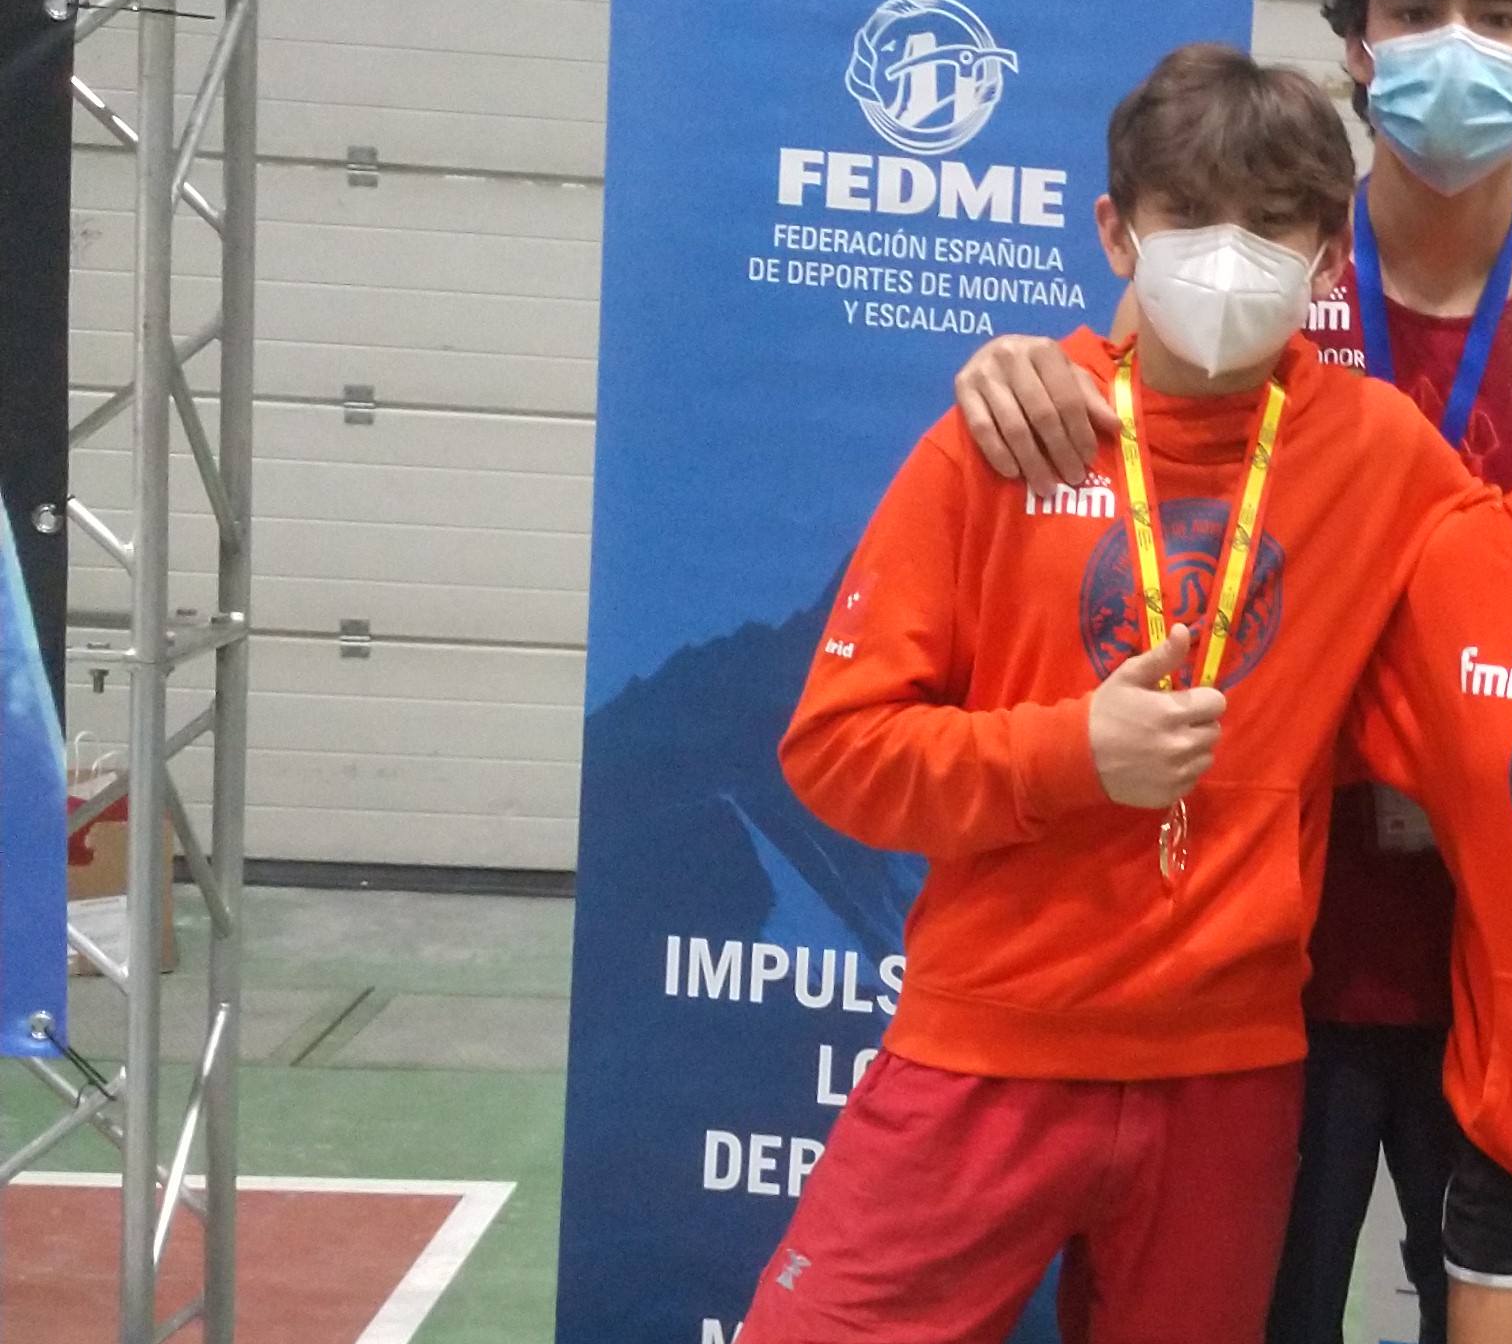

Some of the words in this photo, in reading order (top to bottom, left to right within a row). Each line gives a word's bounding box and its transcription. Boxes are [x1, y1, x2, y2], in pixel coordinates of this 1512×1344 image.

[777, 147, 1067, 228] FEDME
[773, 224, 927, 260] FEDERACIÓN
[935, 238, 1064, 273] ESPAÑOLA
[748, 256, 781, 282] DE
[787, 261, 914, 295] DEPORTES
[921, 272, 952, 298] DE
[959, 274, 1086, 310] MONTAÑA
[843, 300, 859, 325] Y
[864, 304, 994, 337] ESCALADA
[665, 935, 907, 1016] IMPULS
[703, 1129, 826, 1198] DEP
